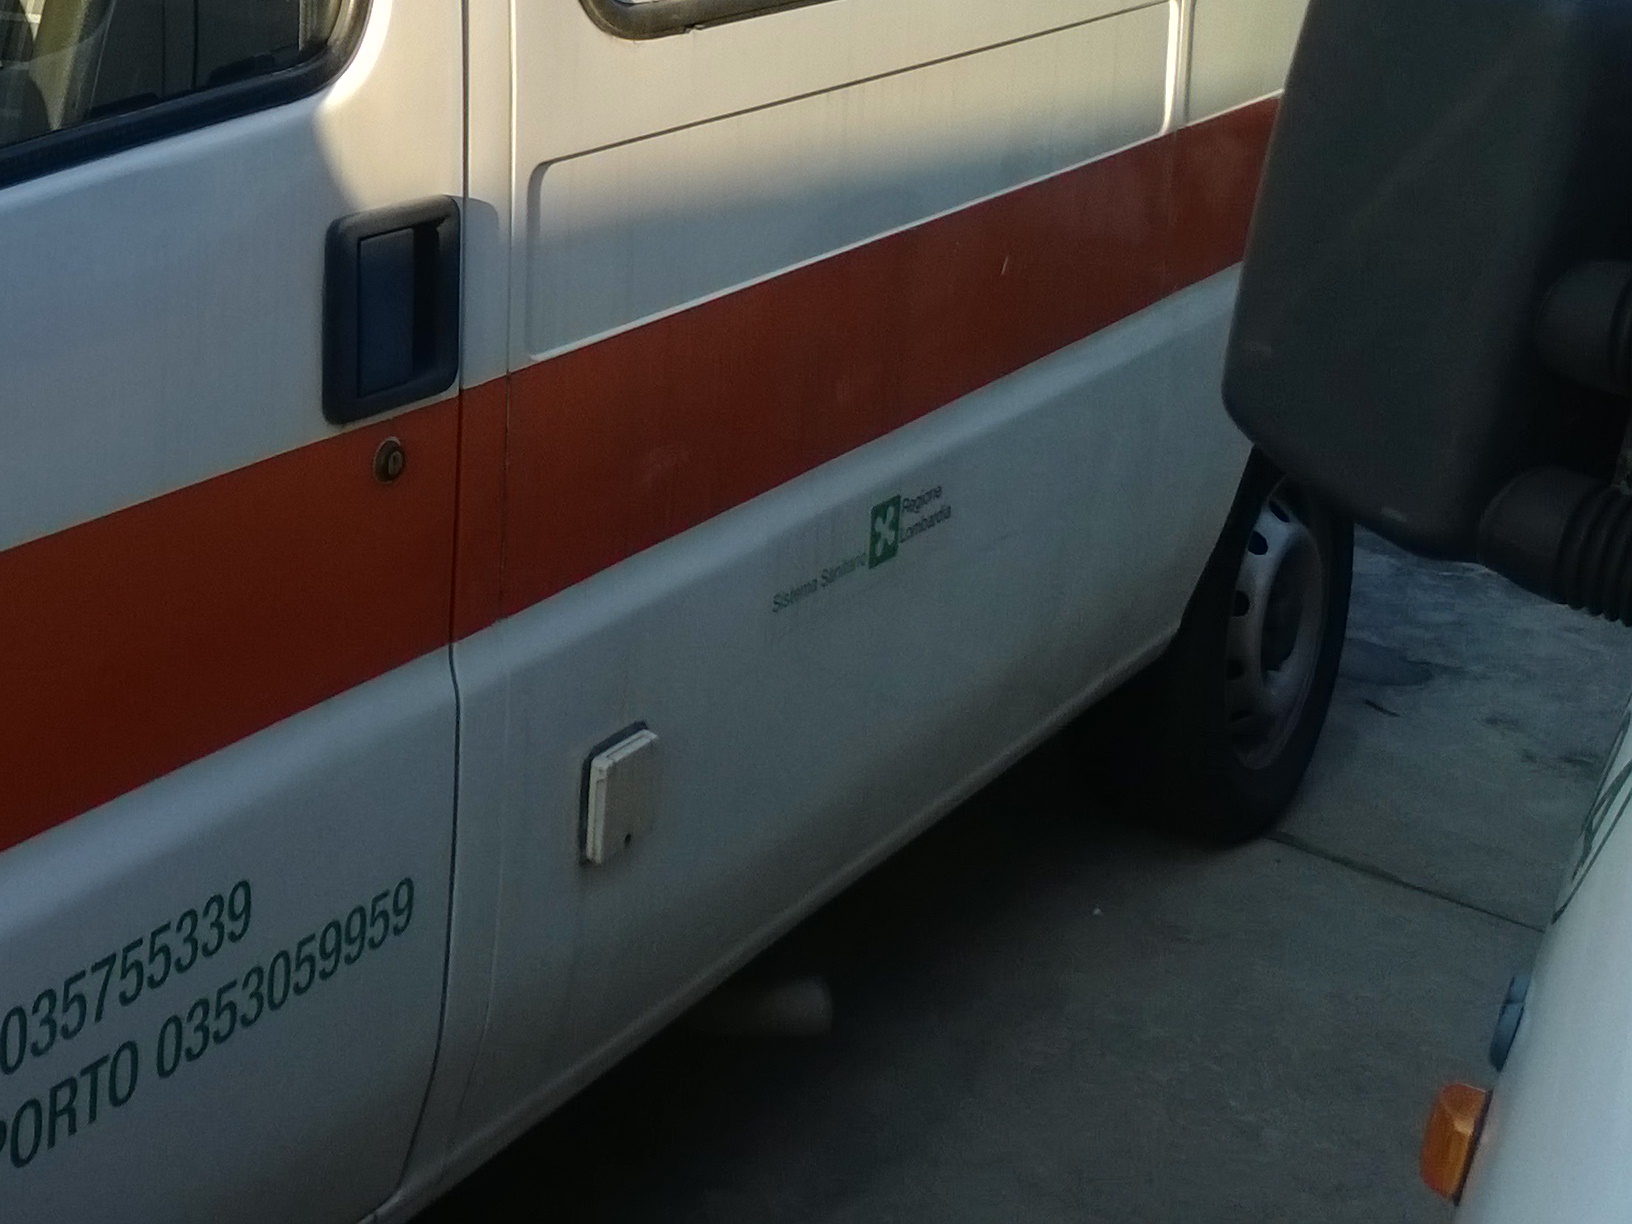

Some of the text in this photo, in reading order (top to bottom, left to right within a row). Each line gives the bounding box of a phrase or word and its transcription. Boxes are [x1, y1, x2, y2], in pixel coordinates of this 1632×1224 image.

[900, 504, 953, 544] Lombardia
[902, 485, 943, 515] Regione
[771, 552, 867, 613] Sistema Sanitario
[156, 876, 416, 1079] 0353059959
